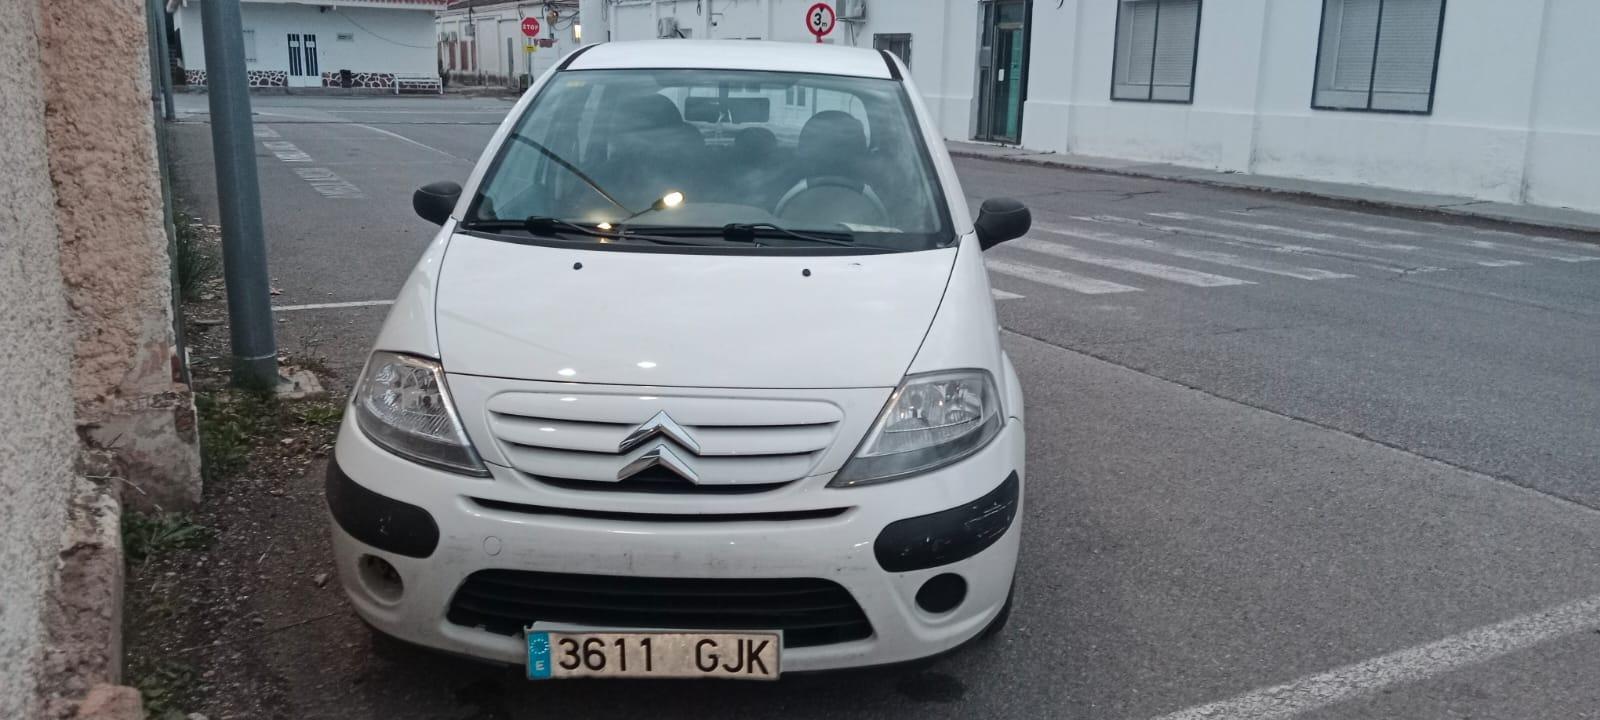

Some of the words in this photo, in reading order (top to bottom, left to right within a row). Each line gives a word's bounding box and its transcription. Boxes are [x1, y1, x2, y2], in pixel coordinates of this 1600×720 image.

[535, 661, 545, 671] E
[558, 637, 652, 672] 3611
[695, 638, 769, 675] GJK
